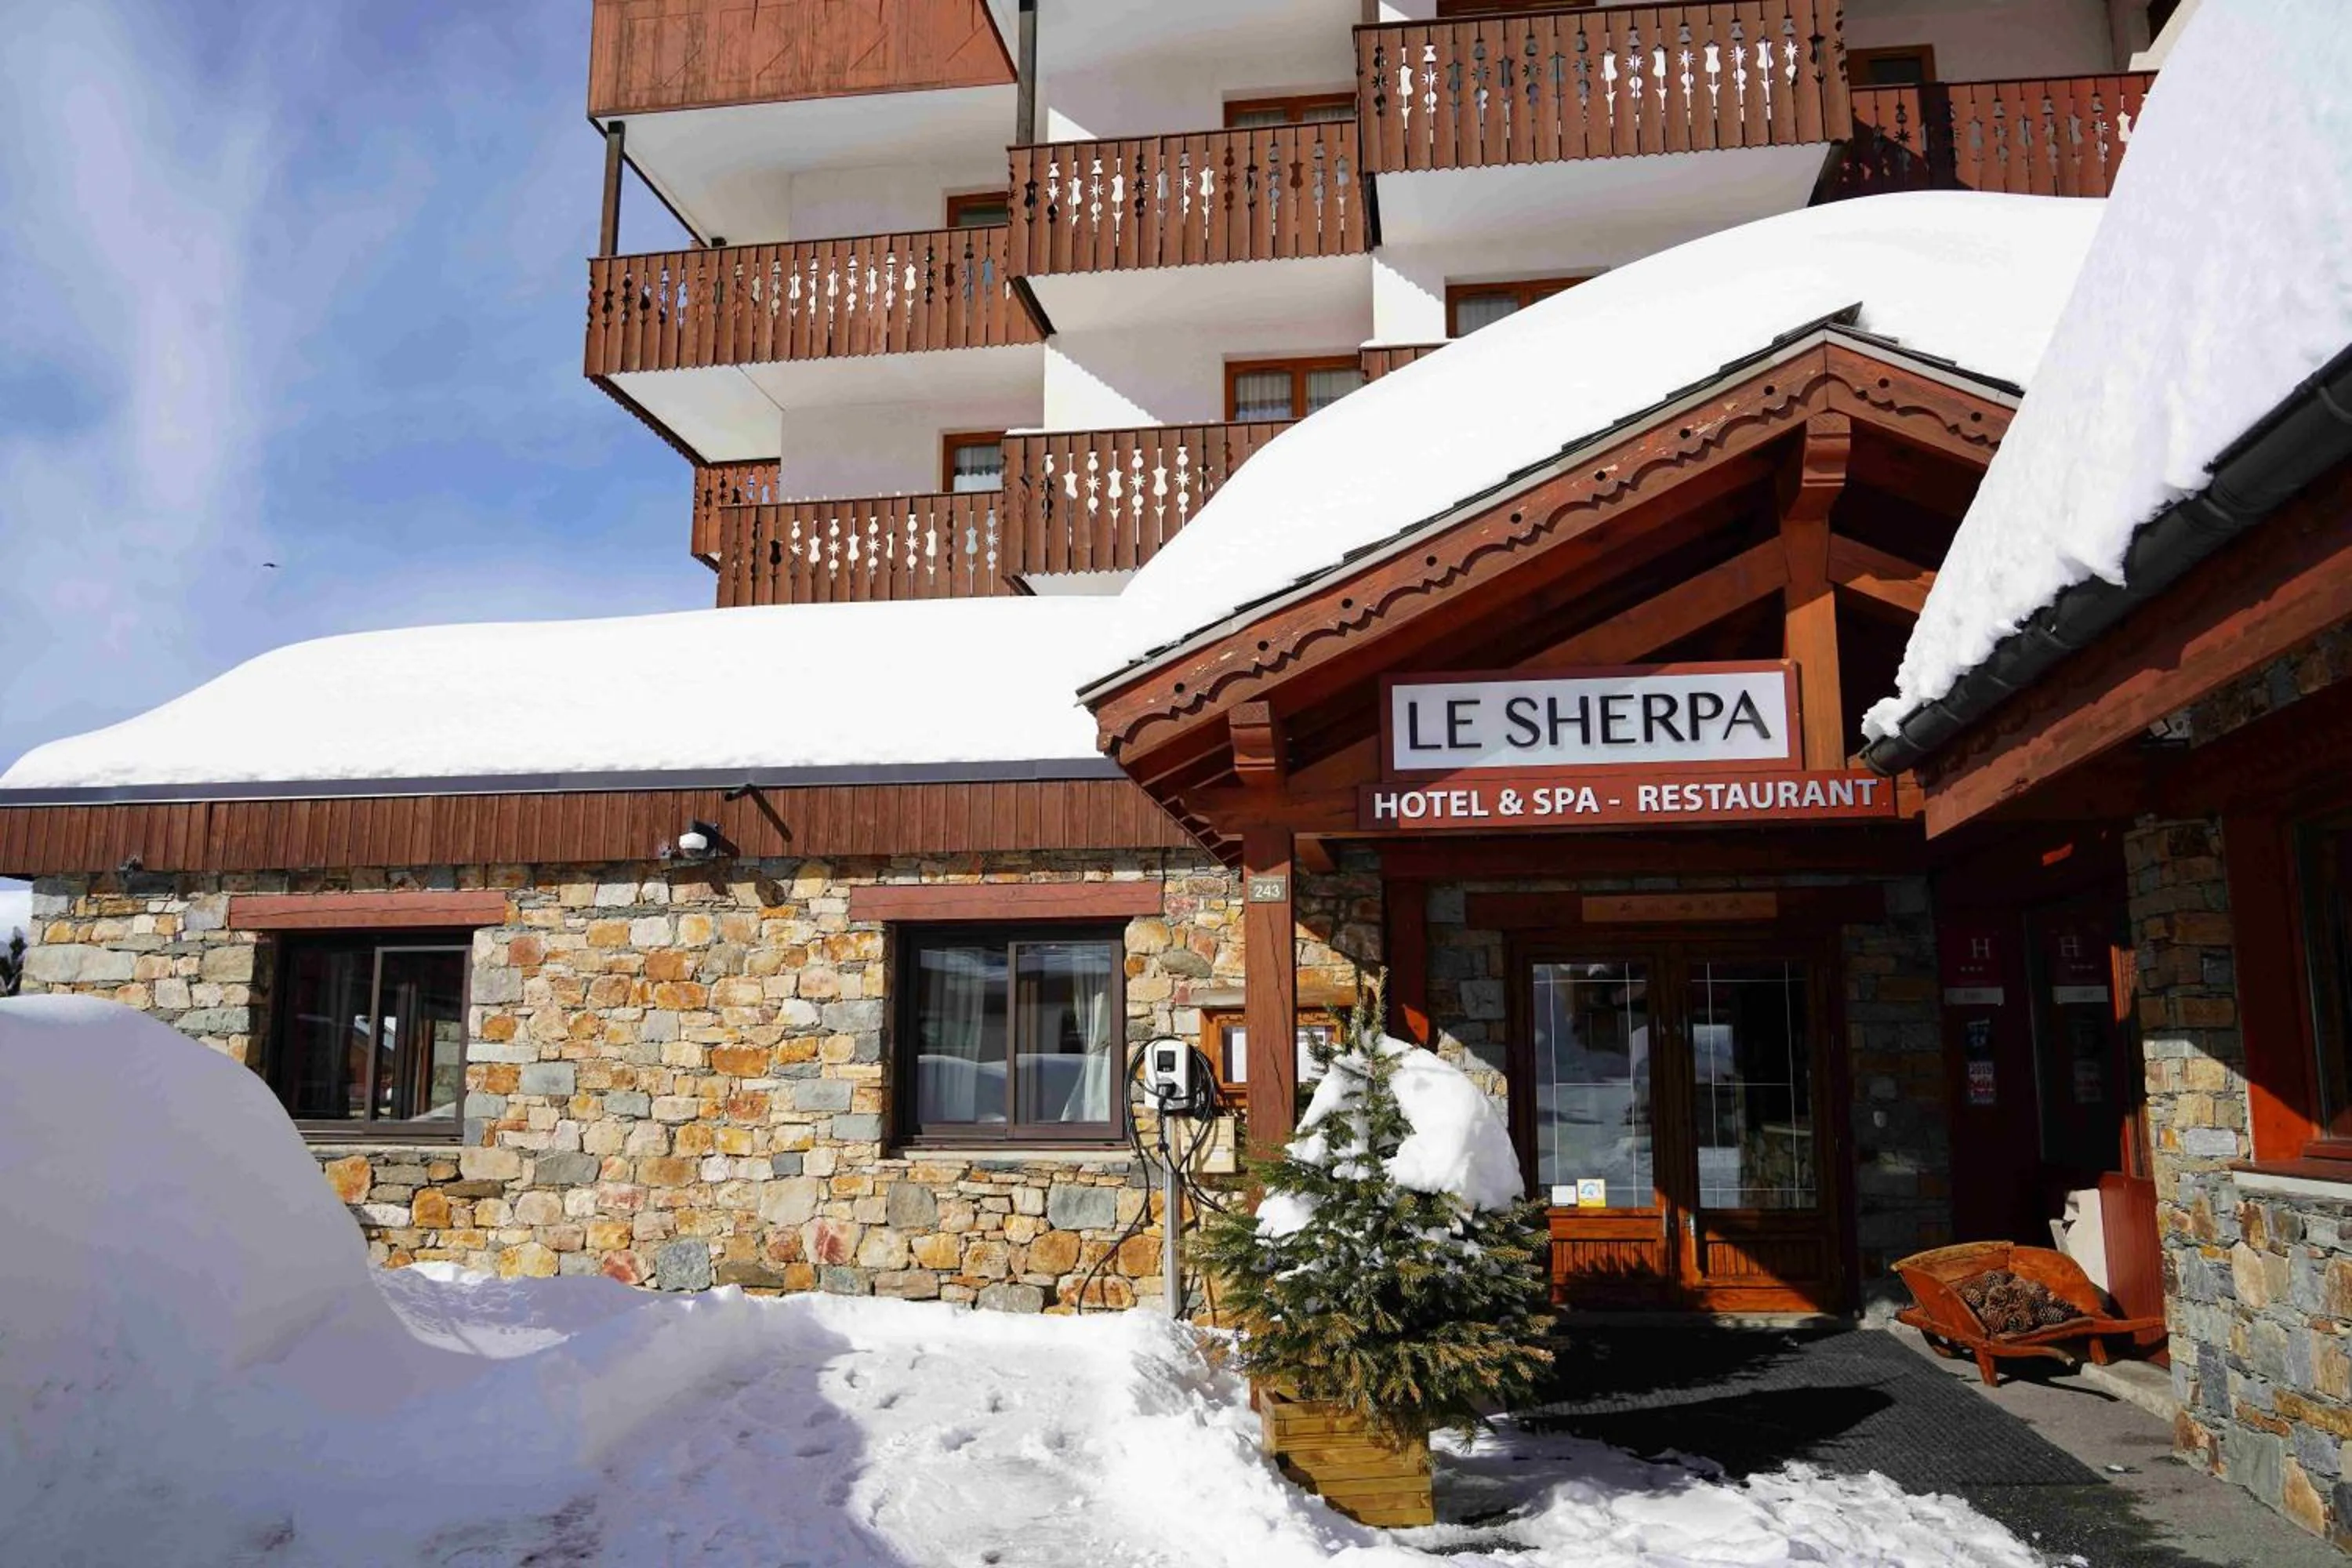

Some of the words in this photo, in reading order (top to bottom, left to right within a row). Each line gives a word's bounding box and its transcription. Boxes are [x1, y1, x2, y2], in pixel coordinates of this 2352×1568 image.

[1408, 699, 1482, 750] LE
[1505, 689, 1771, 749] SHERPA
[1374, 790, 1489, 818] HOTEL
[1498, 789, 1524, 815] &
[1533, 786, 1600, 815] SPA
[1638, 779, 1878, 812] RESTAURANT
[1254, 884, 1280, 898] 243
[1971, 938, 1991, 960] H
